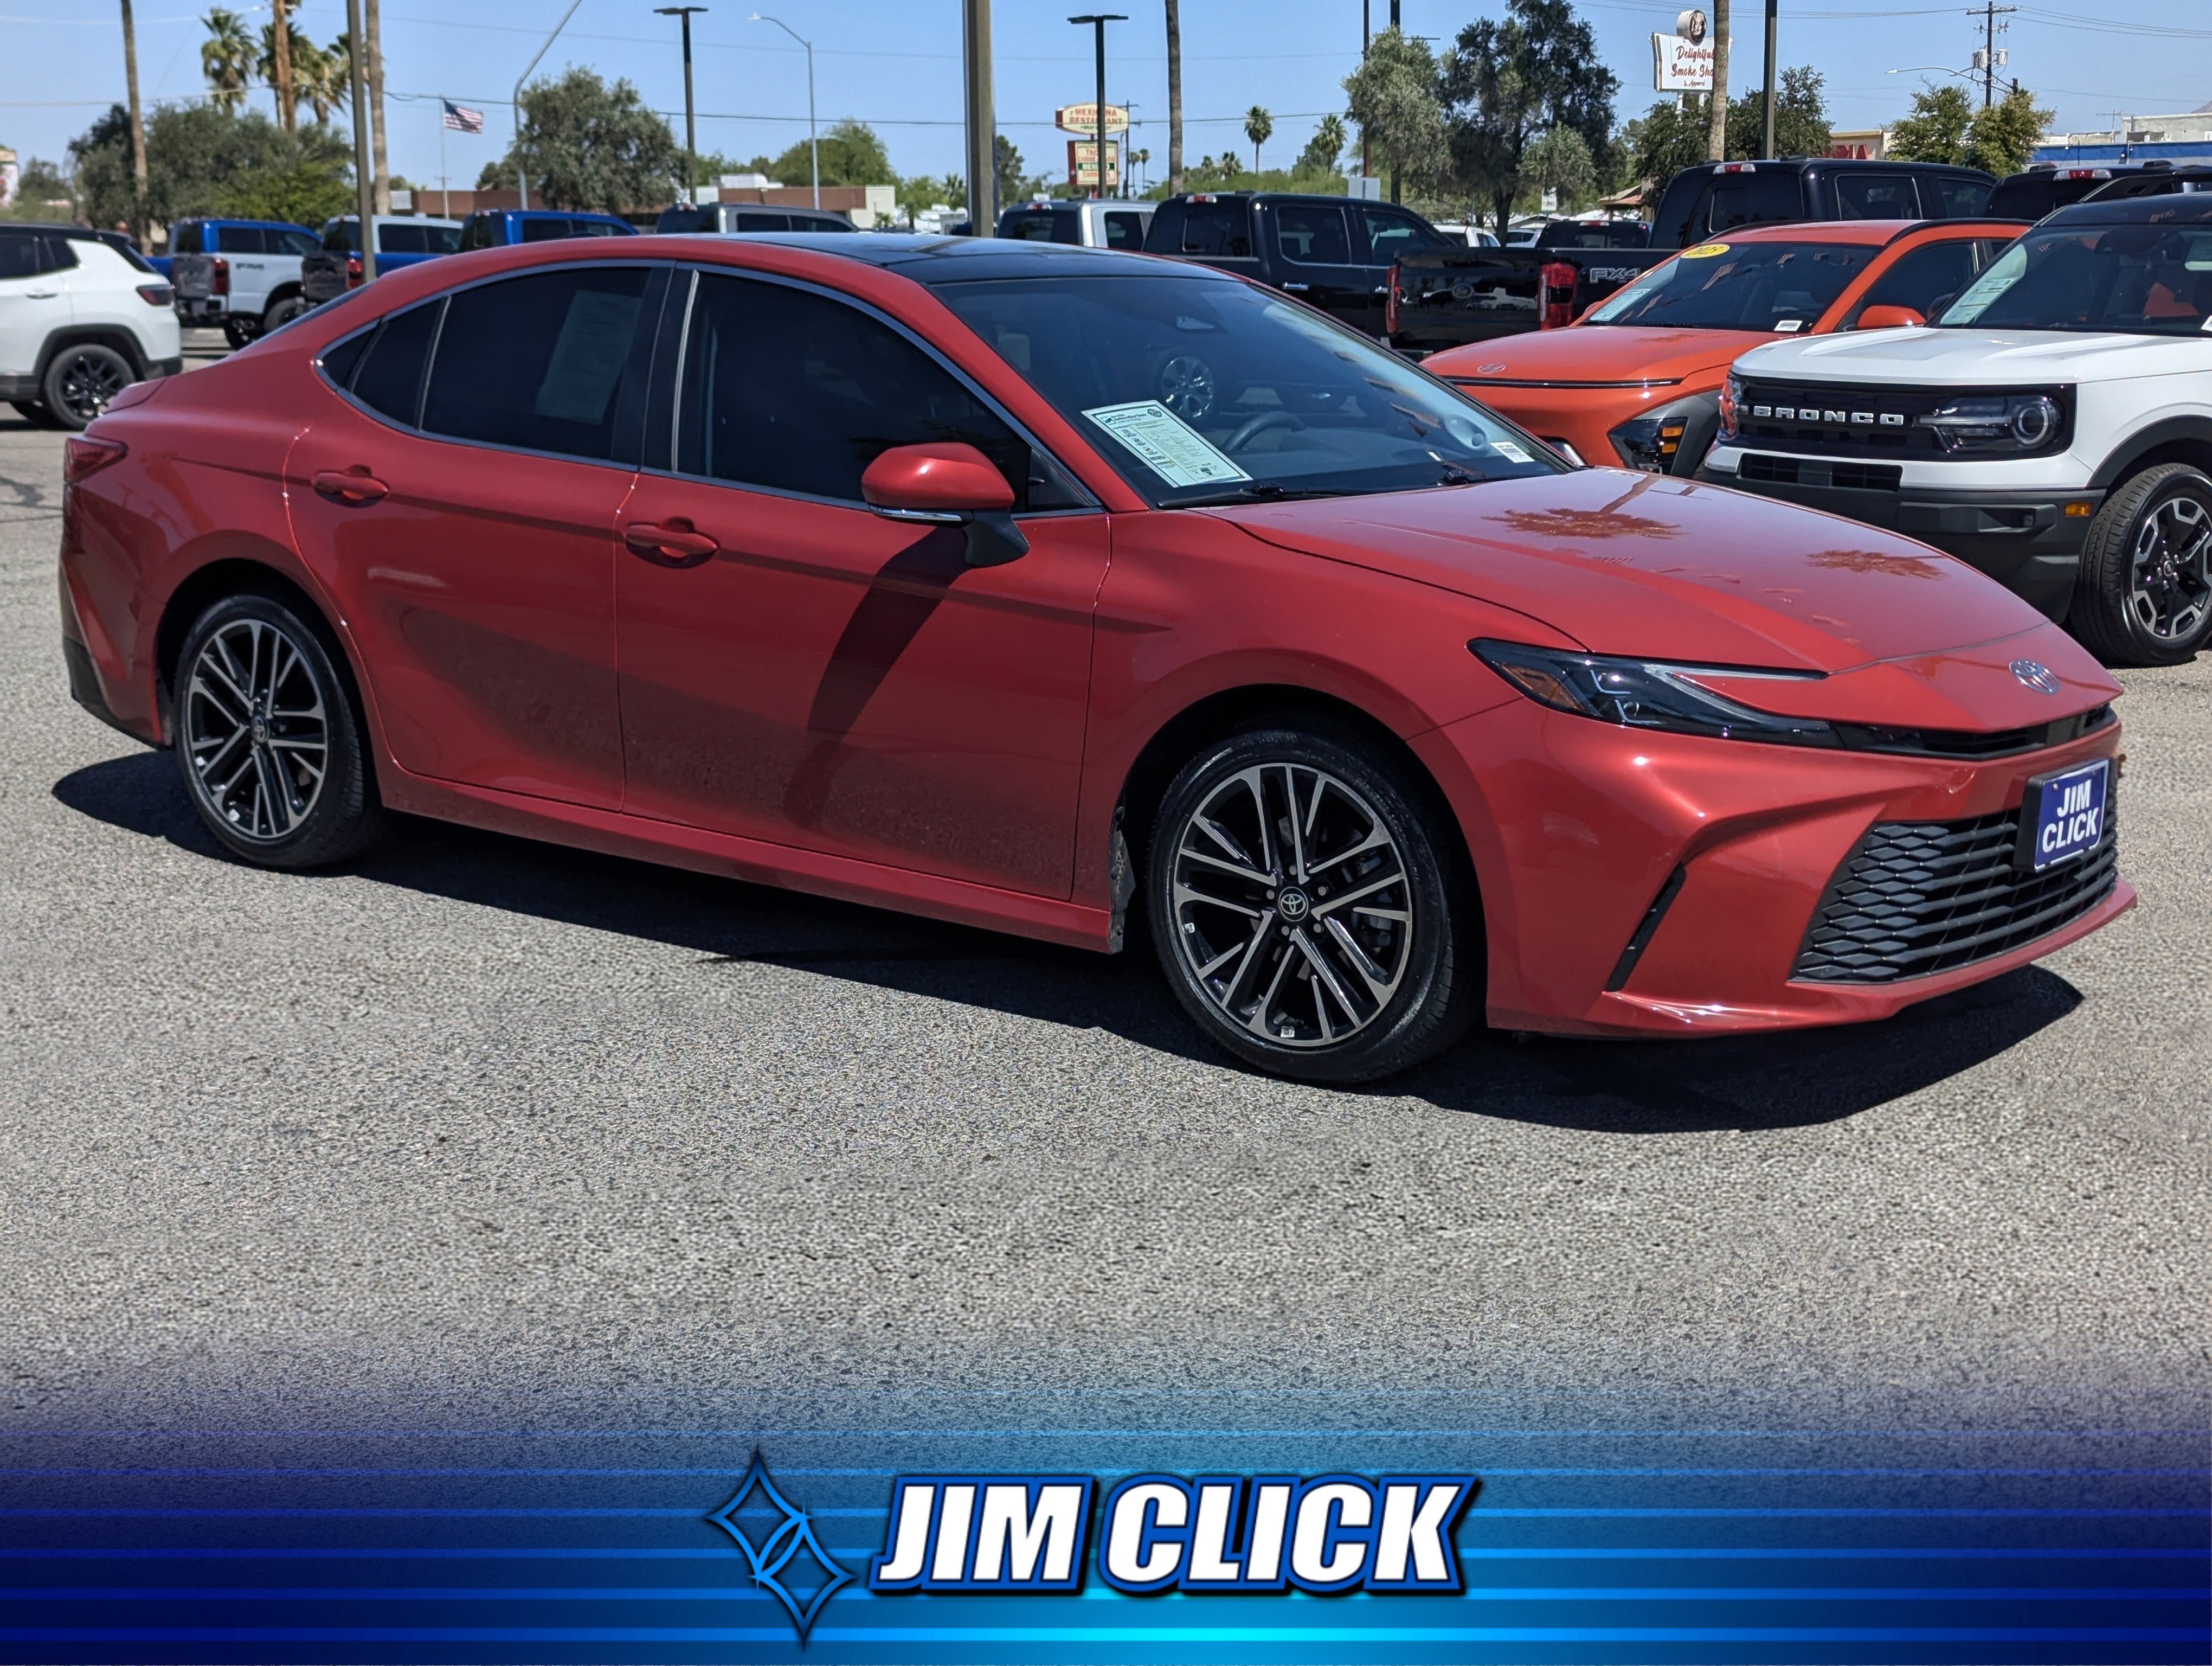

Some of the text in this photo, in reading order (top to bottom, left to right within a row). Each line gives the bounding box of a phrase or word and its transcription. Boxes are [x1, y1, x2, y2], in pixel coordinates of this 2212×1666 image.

[1676, 45, 1715, 63] Delightful
[1671, 63, 1714, 78] Smoke Sho
[1070, 117, 1122, 125] RESTAANT
[1590, 268, 1640, 283] FX4
[1753, 406, 1904, 425] BRONCO
[2057, 779, 2091, 817] JIM
[2042, 807, 2099, 853] CLICK
